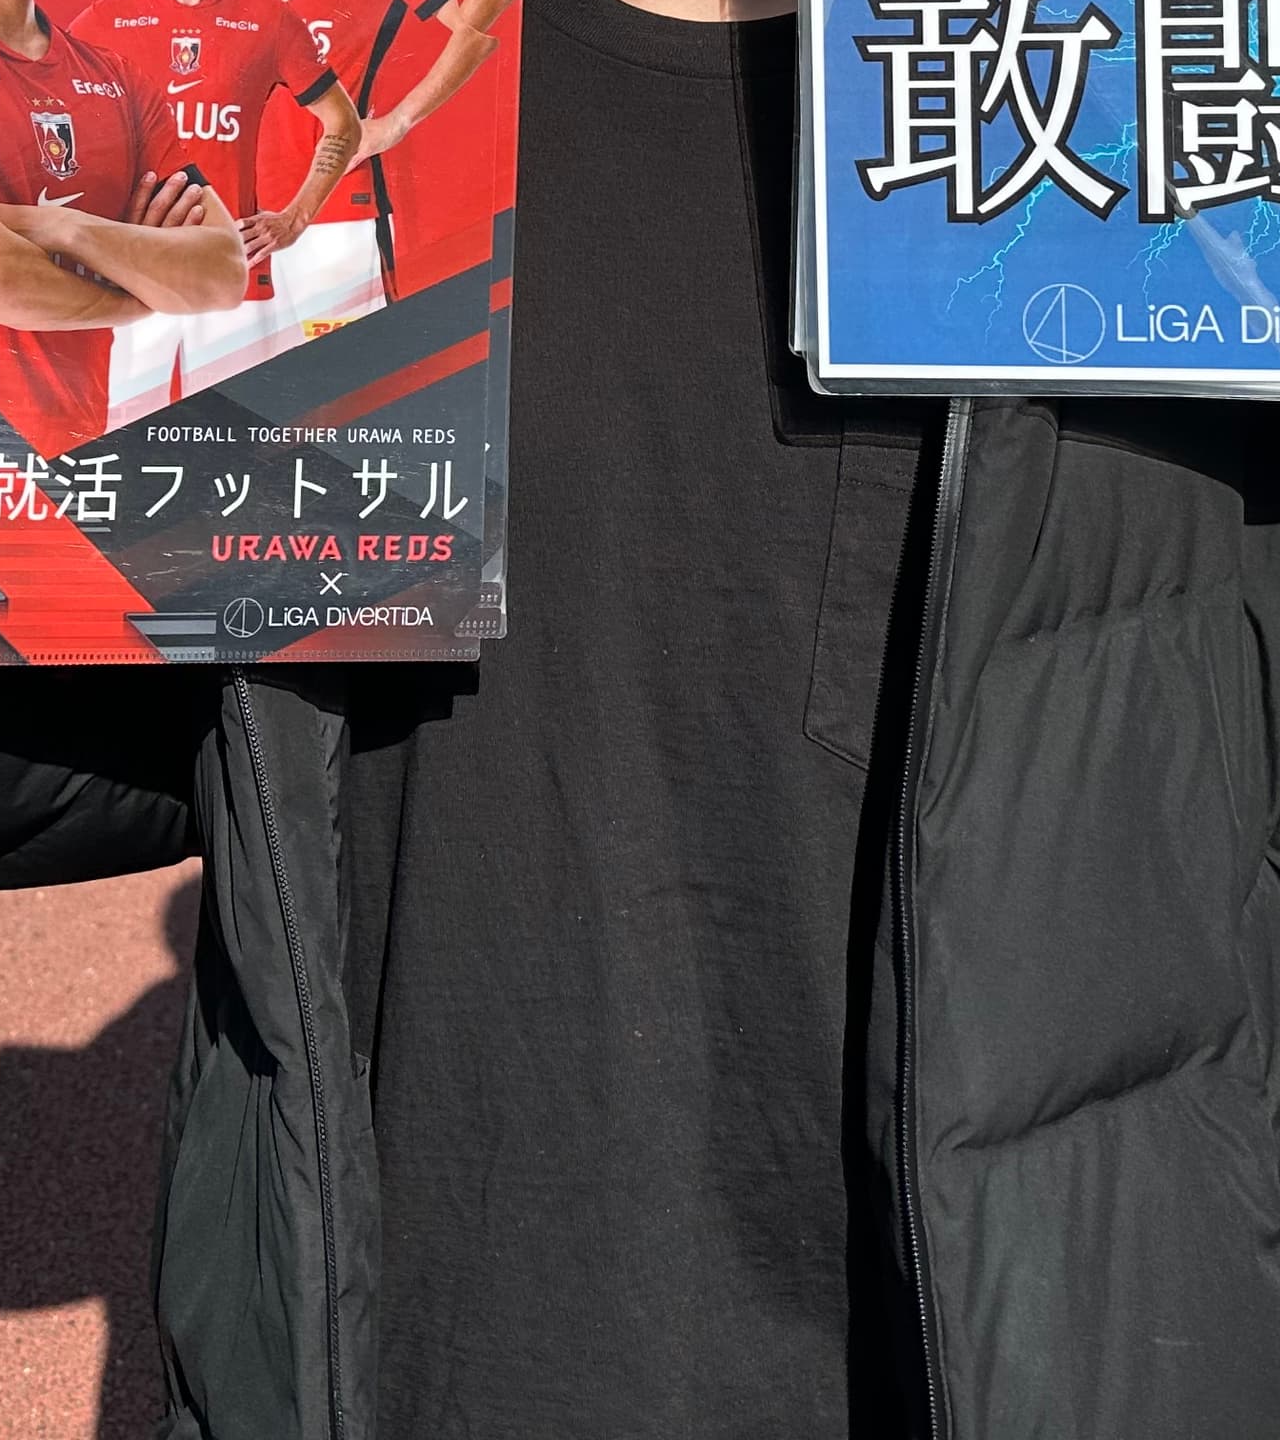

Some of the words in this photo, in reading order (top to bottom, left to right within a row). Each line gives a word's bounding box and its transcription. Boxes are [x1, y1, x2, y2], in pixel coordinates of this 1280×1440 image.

[168, 101, 241, 142] LUS
[147, 426, 237, 442] FOOTBALL
[248, 427, 337, 443] TOGETHER
[347, 428, 403, 444] URAWA
[412, 428, 456, 444] REDS
[211, 535, 343, 561] URAWA
[357, 535, 455, 561] REDS
